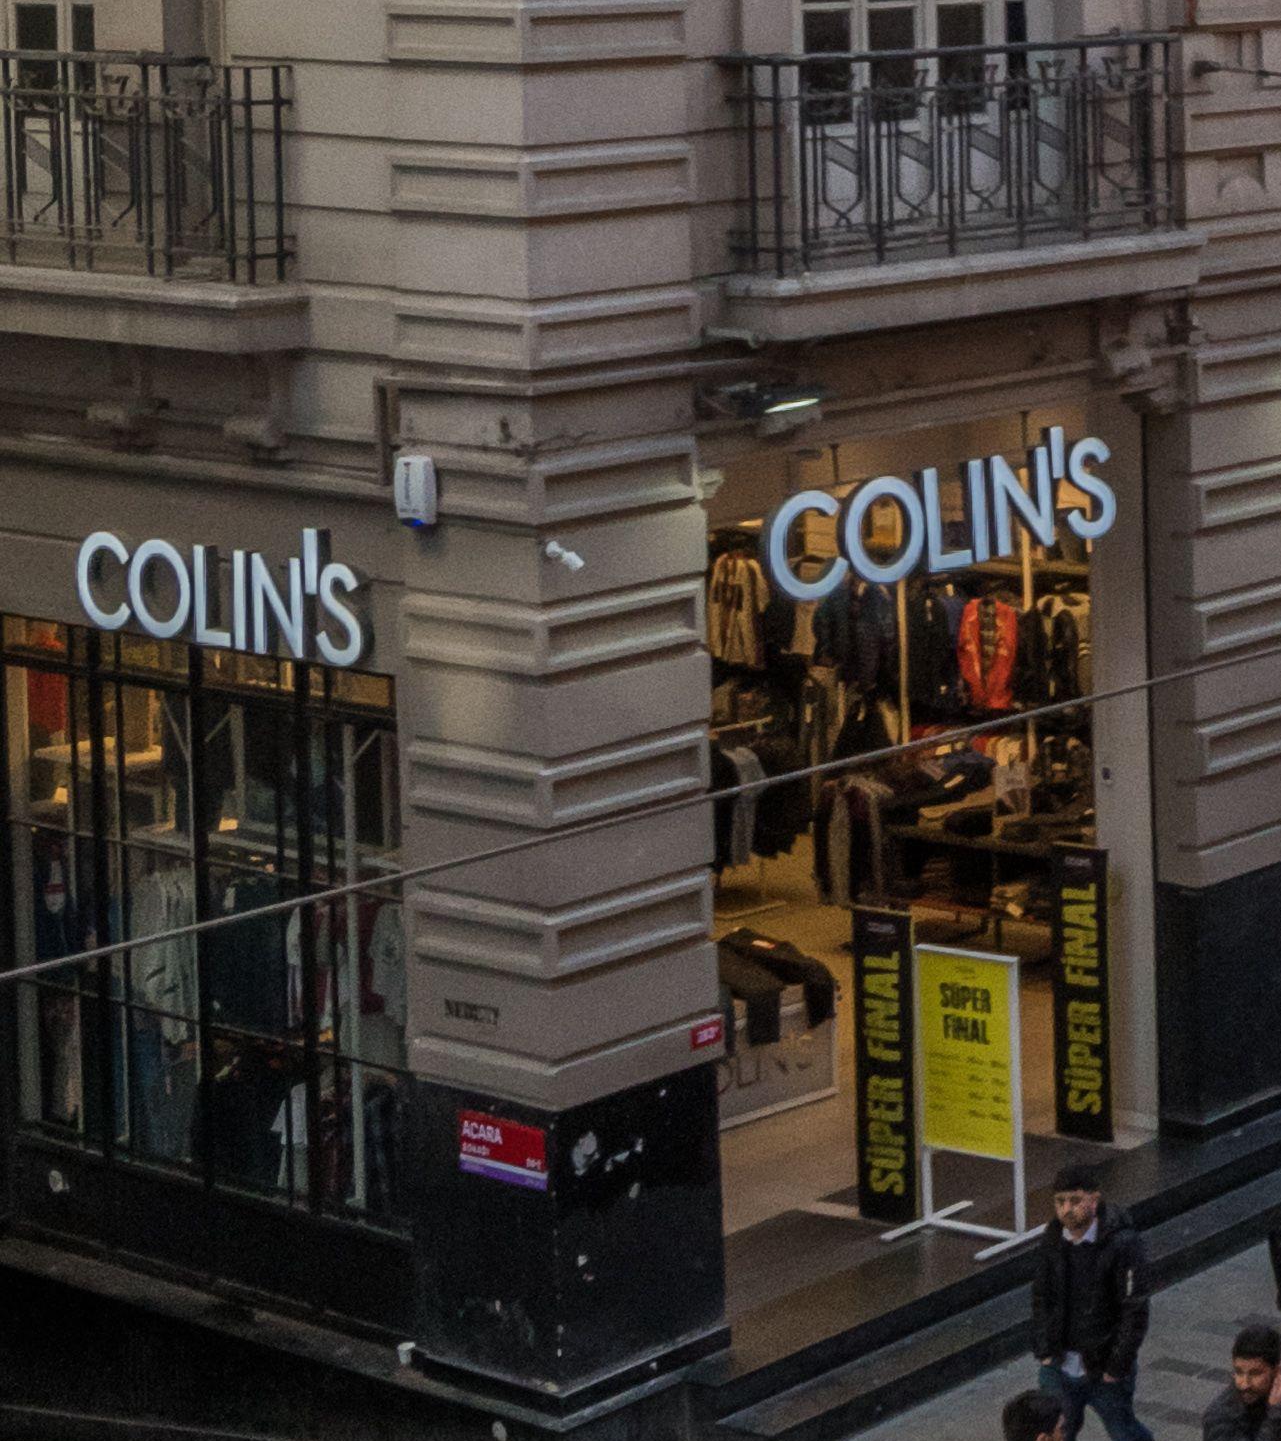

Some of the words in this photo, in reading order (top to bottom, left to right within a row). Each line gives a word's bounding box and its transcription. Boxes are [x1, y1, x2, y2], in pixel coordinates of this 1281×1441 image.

[766, 427, 1117, 602] COLIN'S
[77, 527, 366, 668] COLIN'S
[1060, 882, 1101, 988] FİNAL
[862, 949, 903, 1062] FİNAL
[1066, 1000, 1103, 1116] SÜPER
[865, 1072, 906, 1196] SÜPER
